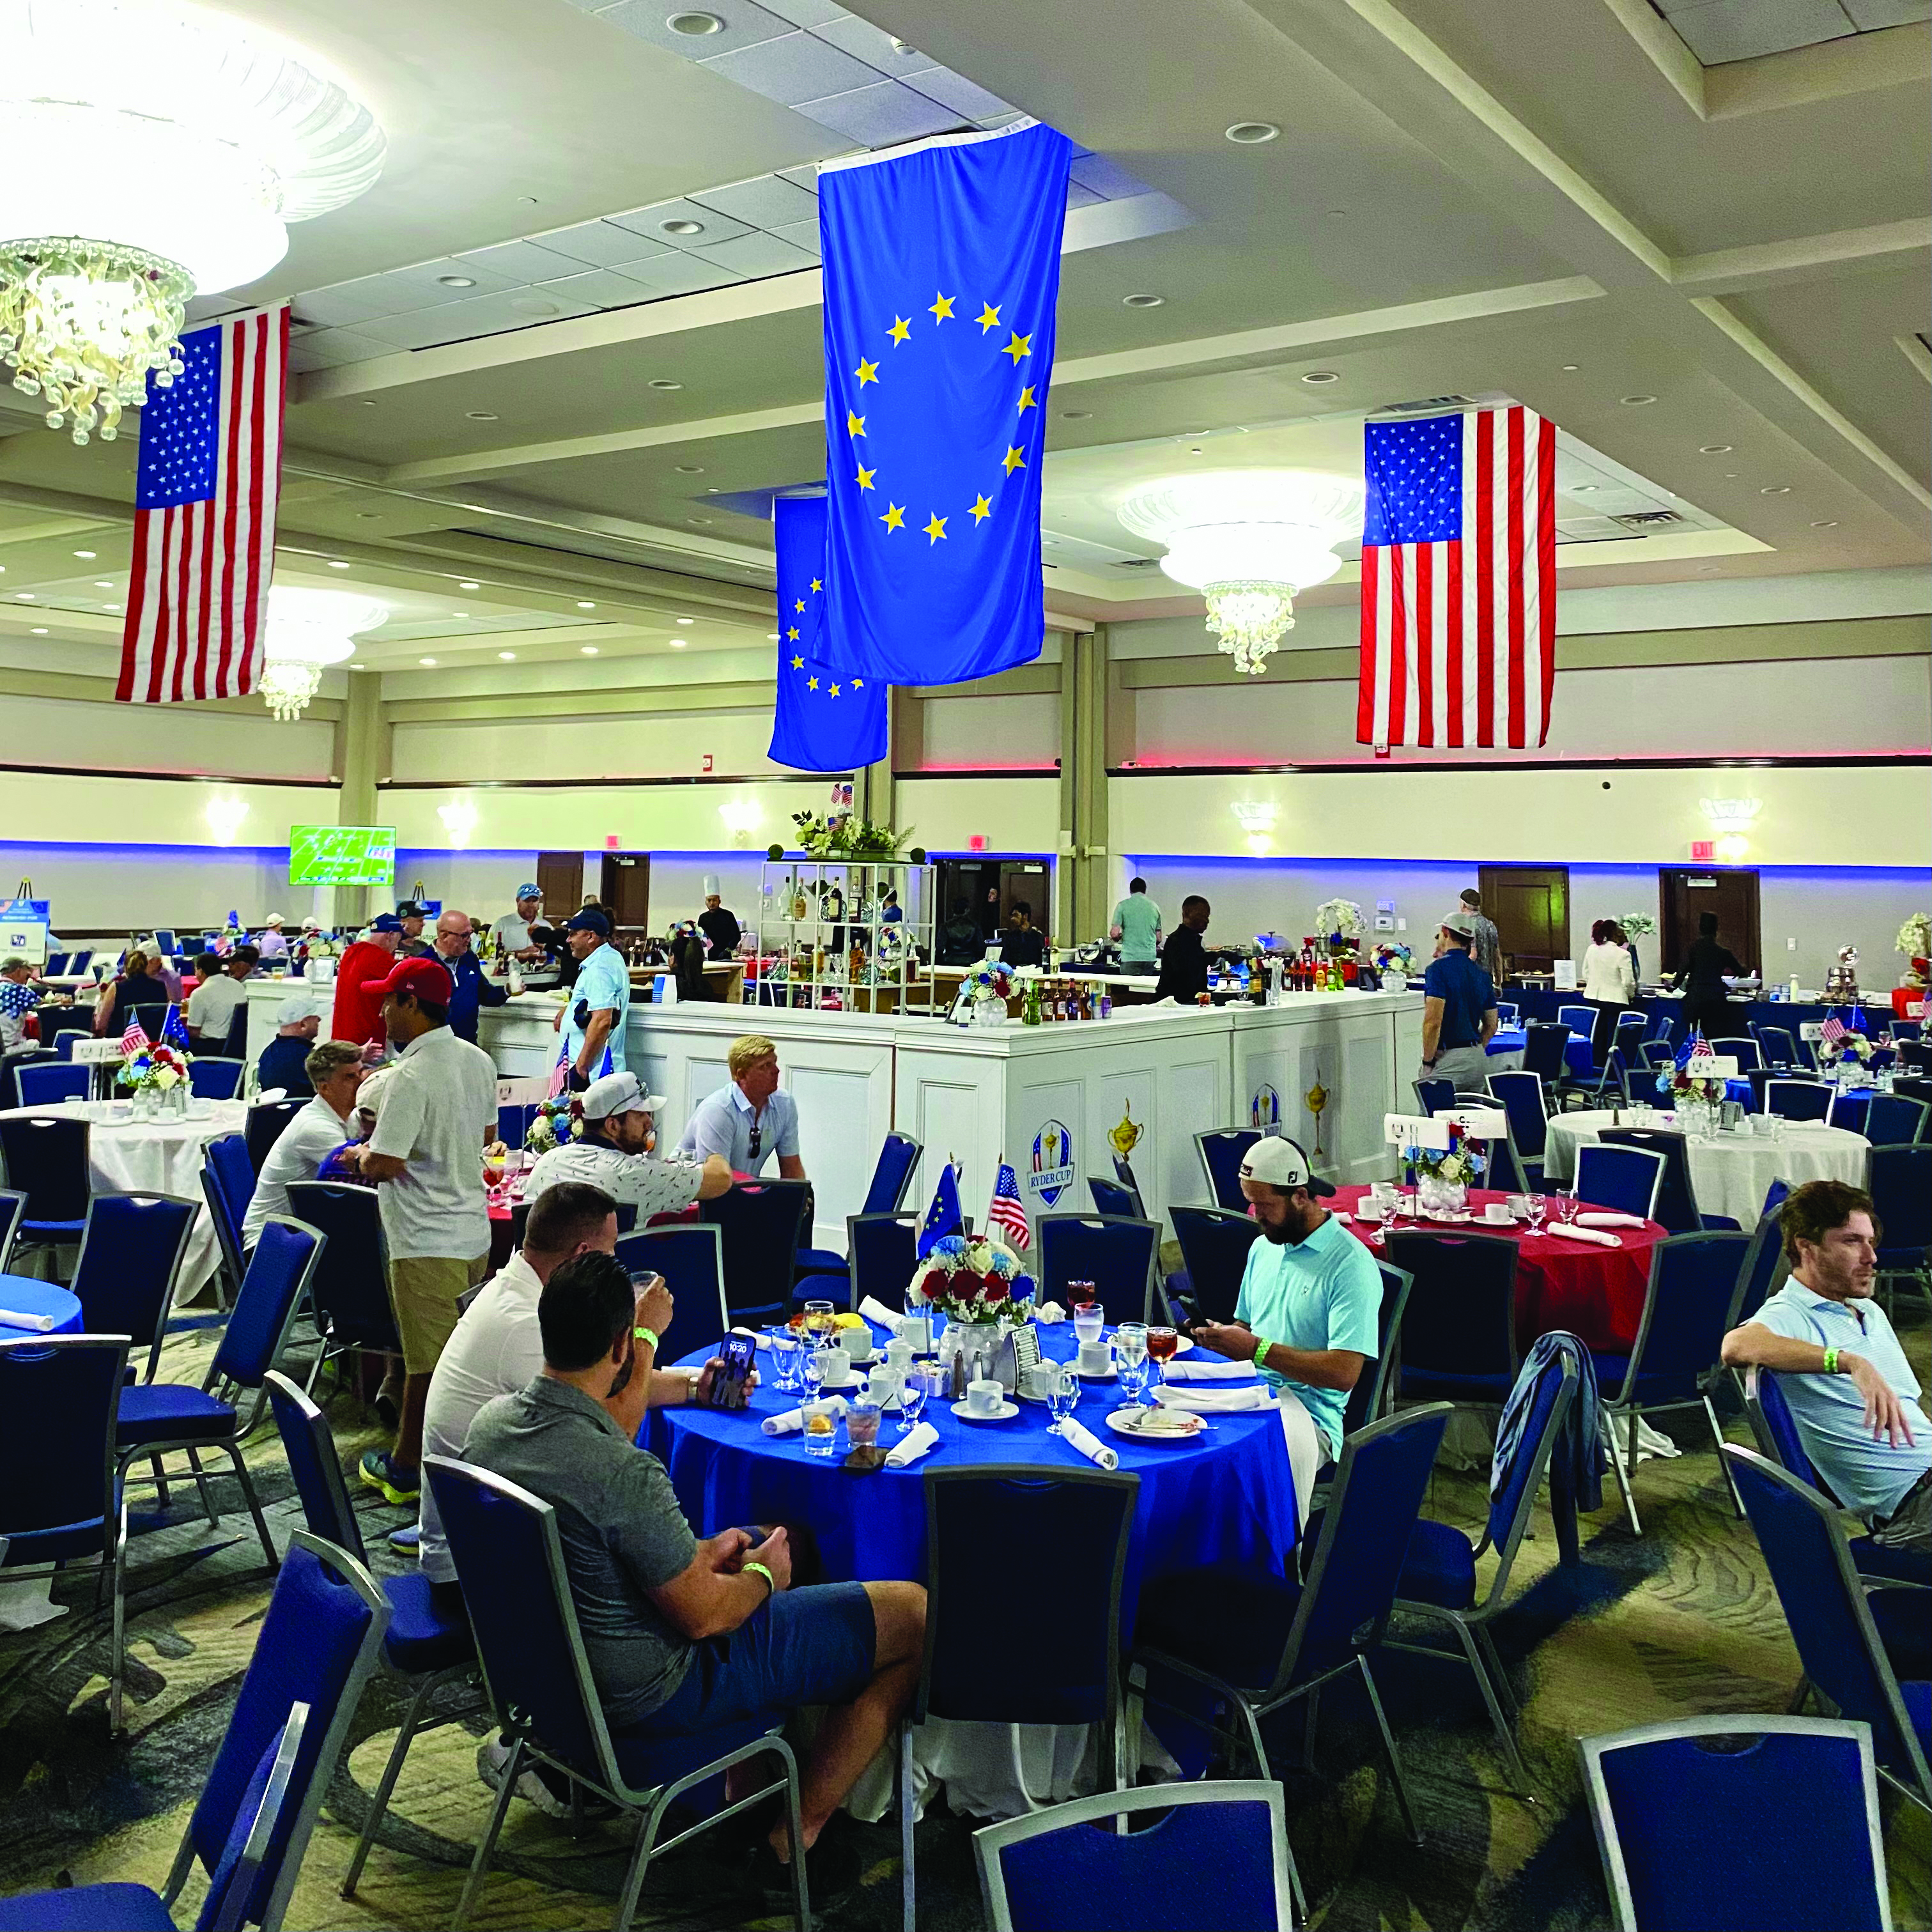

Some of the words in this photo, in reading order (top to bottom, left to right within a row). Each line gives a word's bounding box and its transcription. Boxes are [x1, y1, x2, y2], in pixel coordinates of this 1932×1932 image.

[1693, 842, 1713, 857] EXIT
[1031, 1173, 1055, 1187] RYDER
[1056, 1170, 1071, 1182] CUP
[1288, 1171, 1298, 1184] FJ
